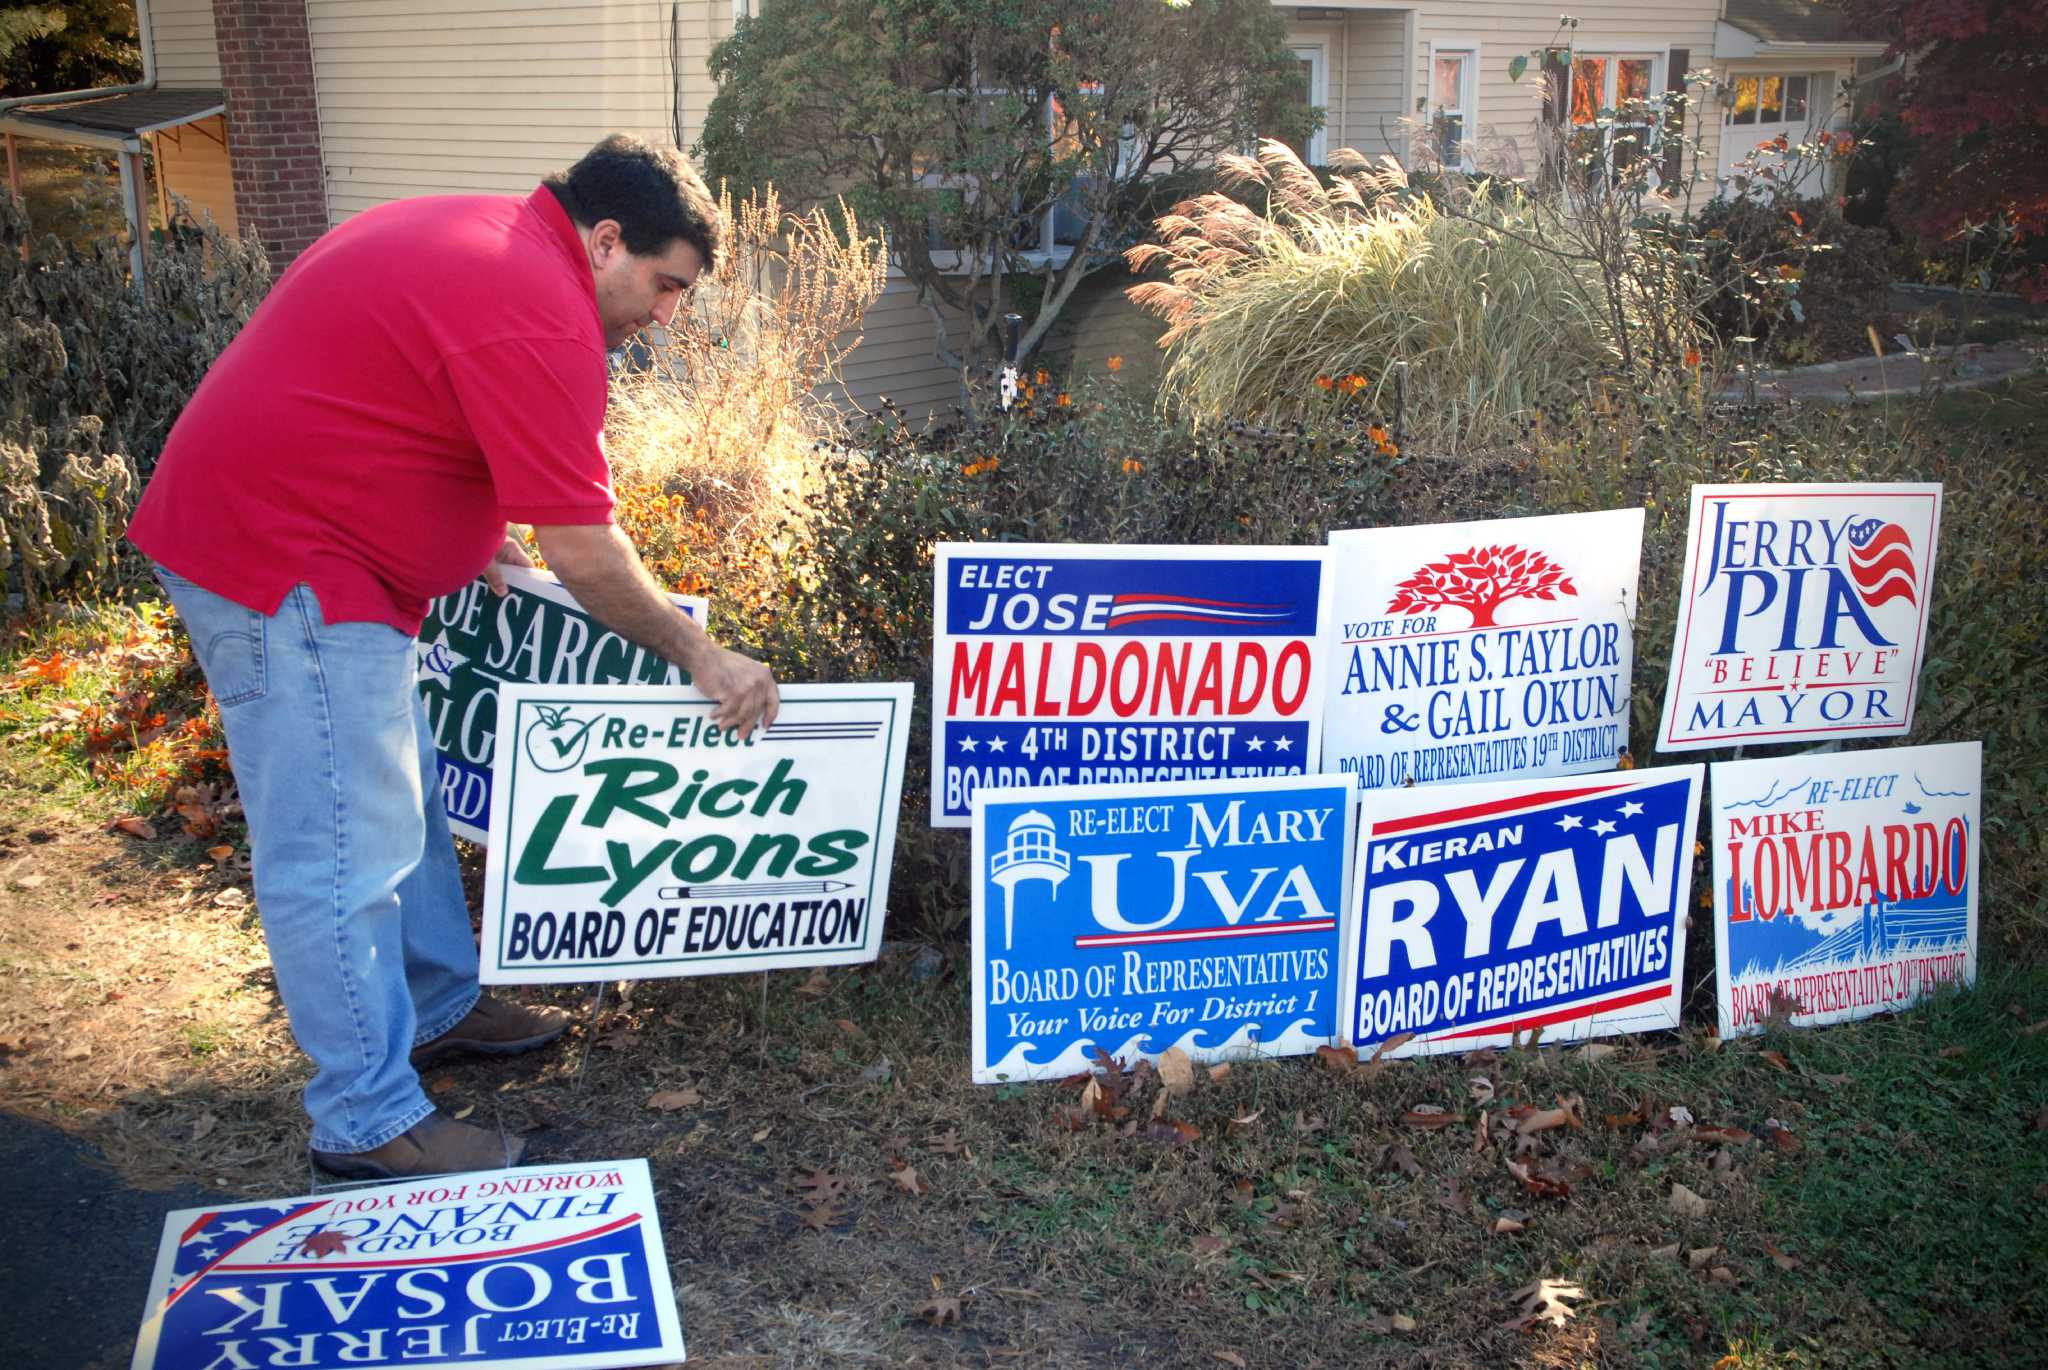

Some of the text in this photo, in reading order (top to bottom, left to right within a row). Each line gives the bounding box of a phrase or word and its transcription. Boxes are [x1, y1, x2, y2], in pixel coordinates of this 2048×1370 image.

[959, 565, 1053, 589] ELECT
[1698, 501, 1859, 598] JERRY
[425, 580, 488, 636] OE
[969, 594, 1113, 631] JOSE
[1343, 616, 1437, 640] VOTE FOR
[1709, 566, 1899, 656] PIA
[425, 643, 453, 677] &
[946, 640, 1312, 718] MALDONADO
[1341, 622, 1620, 695] ANNIE S. TAYLOR
[601, 716, 758, 749] Re-Elect
[1380, 673, 1619, 740] & GAIL OKUN
[1685, 688, 1896, 732] MAYOR
[1020, 727, 1236, 761] 4TH DISTRICT
[1391, 751, 1409, 787] OF
[1413, 736, 1527, 783] REPRESENTATIVES
[1532, 732, 1559, 767] 19TH
[1562, 725, 1618, 763] DISTRICT
[580, 757, 808, 828] Rich
[1806, 774, 1899, 805] RE-ELECT
[513, 794, 870, 907] Lyons
[1068, 799, 1335, 849] RE-ELECT MARY
[1371, 824, 1523, 874] KIERAN
[1727, 809, 1825, 840] MIKE
[1076, 848, 1335, 933] UVA
[1727, 817, 1968, 923] LOMBARDO
[507, 897, 866, 961] BOARD OF EDUCATION
[1363, 823, 1679, 980] RYAN
[989, 948, 1329, 1006] BOARD OF REPRESENTATIVES
[1358, 925, 1669, 1040] BOARD OF REPRESENTATIVES
[1794, 962, 1894, 1017] REPRESENTATIVES
[1006, 989, 1318, 1038] Your Voice For District 1
[331, 1190, 400, 1216] YOU
[407, 1184, 471, 1204] FOR
[476, 1171, 625, 1197] WORKING
[285, 1191, 625, 1241] FINANCE
[356, 1224, 517, 1254] BOARD
[201, 1251, 639, 1337] BOSAK
[203, 1311, 640, 1370] RE-ELECT JERRY
